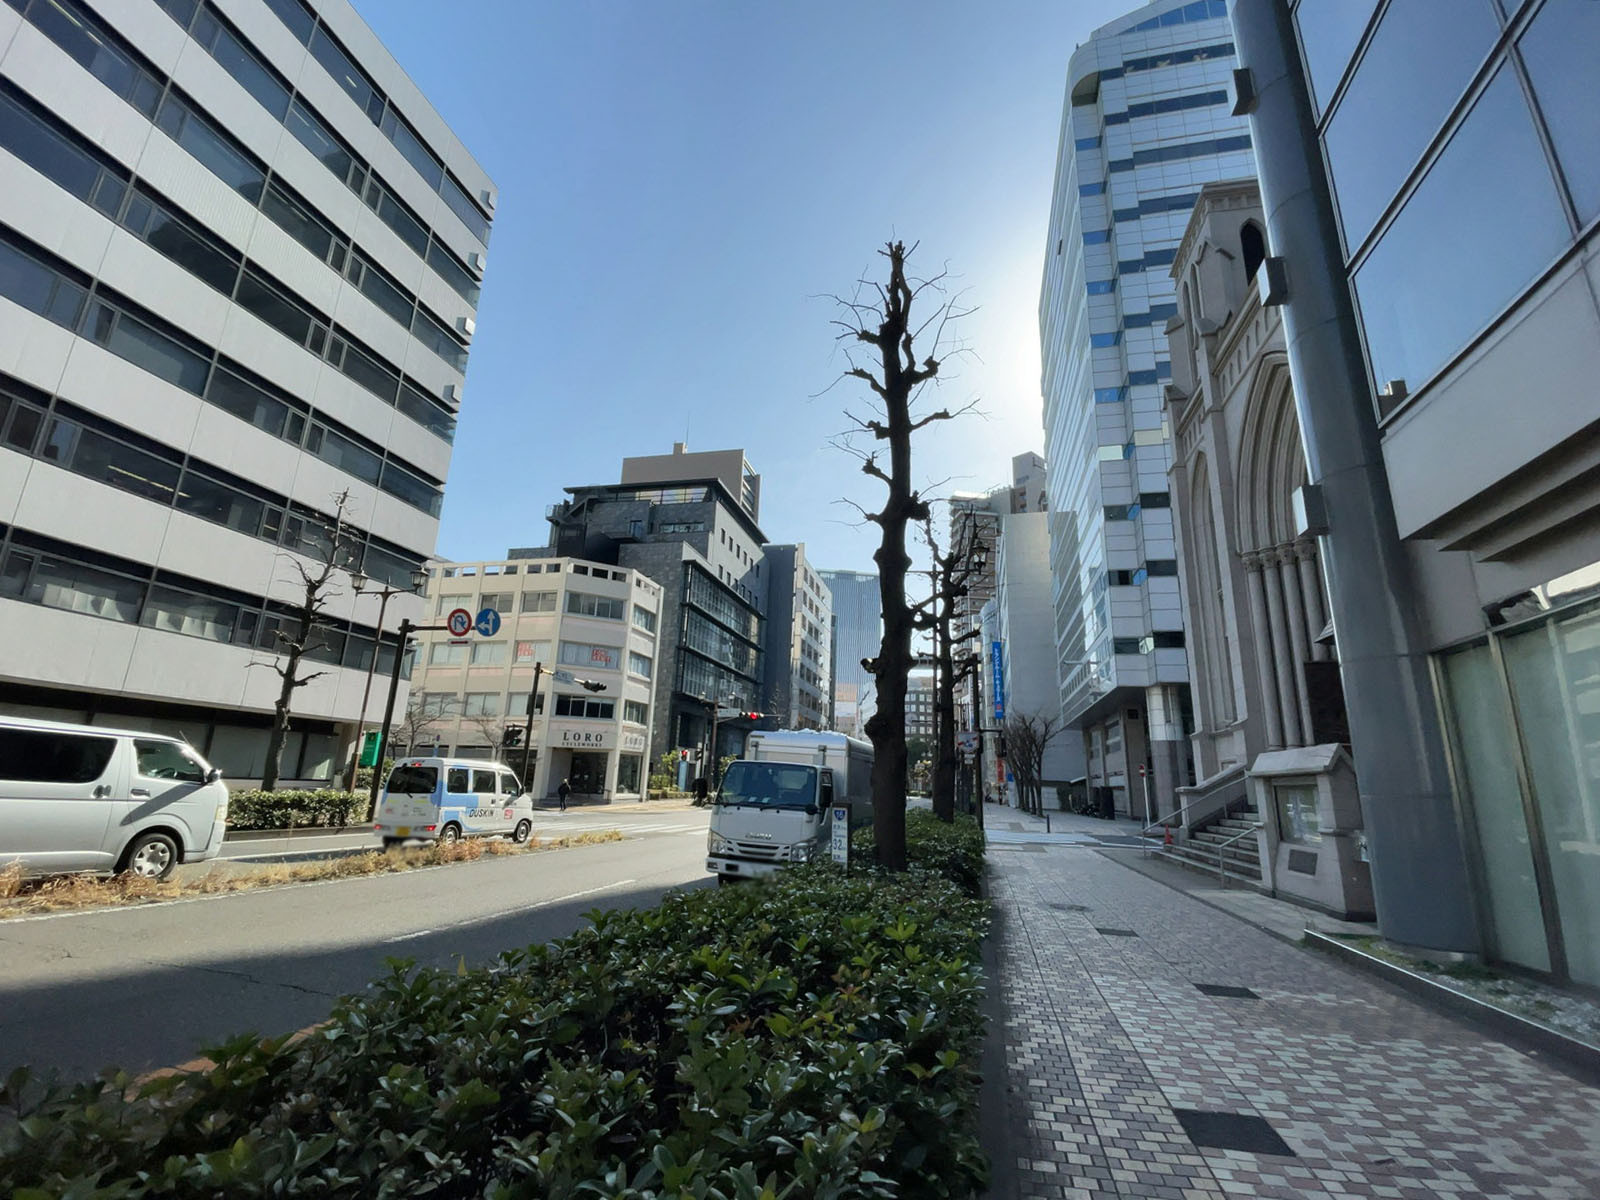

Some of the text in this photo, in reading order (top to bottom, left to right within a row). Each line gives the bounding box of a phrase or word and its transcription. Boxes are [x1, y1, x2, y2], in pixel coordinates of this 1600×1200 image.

[563, 732, 603, 742] LORO
[468, 808, 495, 818] DUSKIN
[832, 838, 843, 850] 32
